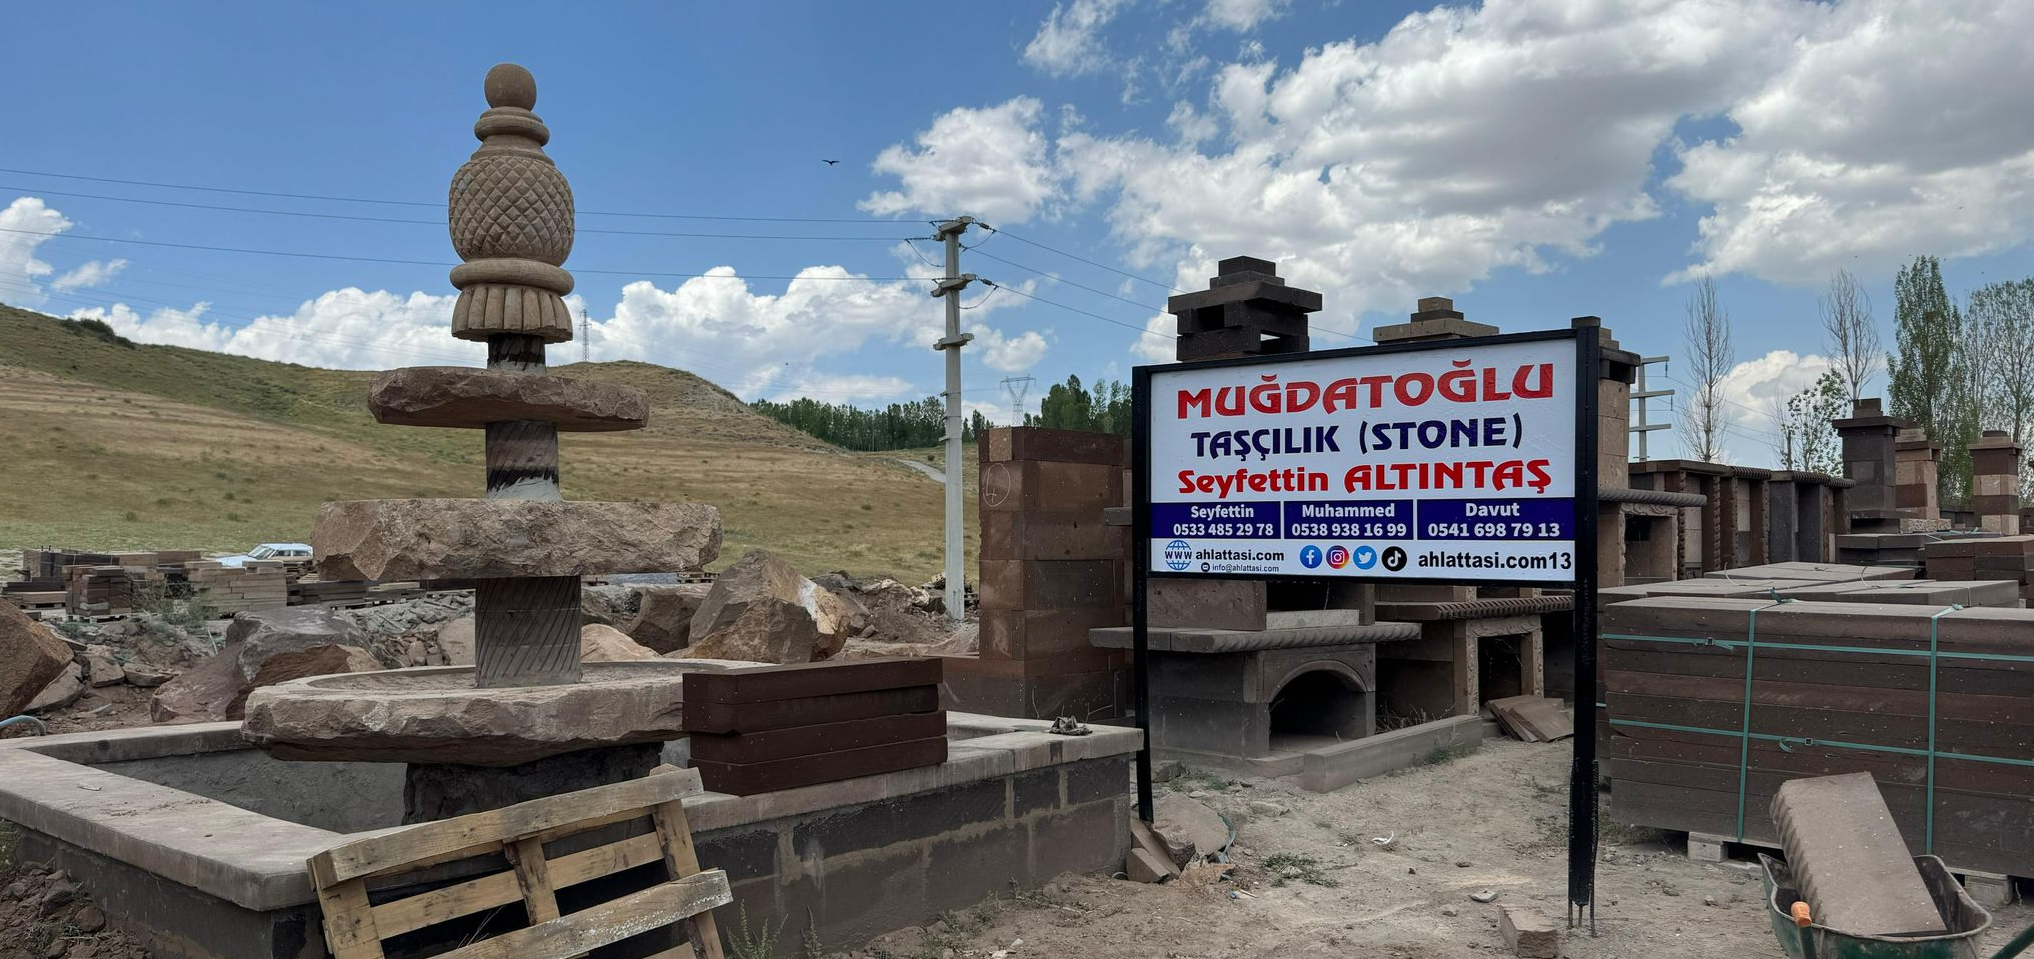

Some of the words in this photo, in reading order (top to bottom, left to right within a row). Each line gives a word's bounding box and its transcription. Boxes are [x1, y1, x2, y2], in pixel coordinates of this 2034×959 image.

[1177, 359, 1554, 419] MUĞDATOĞLU
[1191, 426, 1340, 461] TAŞÇILIK
[1359, 412, 1522, 454] (STONE)
[1178, 467, 1328, 498] Seyfettin
[1344, 459, 1551, 494] ALTINTAŞ
[1191, 504, 1254, 520] Seyfettin
[1302, 504, 1395, 518] Muhammed
[1466, 502, 1520, 517] Davut
[1174, 523, 1205, 536] 0533
[1208, 523, 1232, 536] 485
[1235, 523, 1252, 536] 29
[1256, 523, 1273, 536] 78
[1292, 523, 1327, 537] 0538
[1330, 523, 1360, 537] 938
[1364, 523, 1382, 537] 16
[1386, 523, 1406, 537] 99
[1428, 522, 1469, 537] 0541
[1474, 522, 1507, 537] 698
[1511, 522, 1533, 537] 79
[1539, 522, 1560, 537] 13
[1196, 548, 1284, 561] ahlattasi.com
[1418, 551, 1572, 570] ahlattasi.com13
[1212, 563, 1279, 572] info@ahlattasi.com
